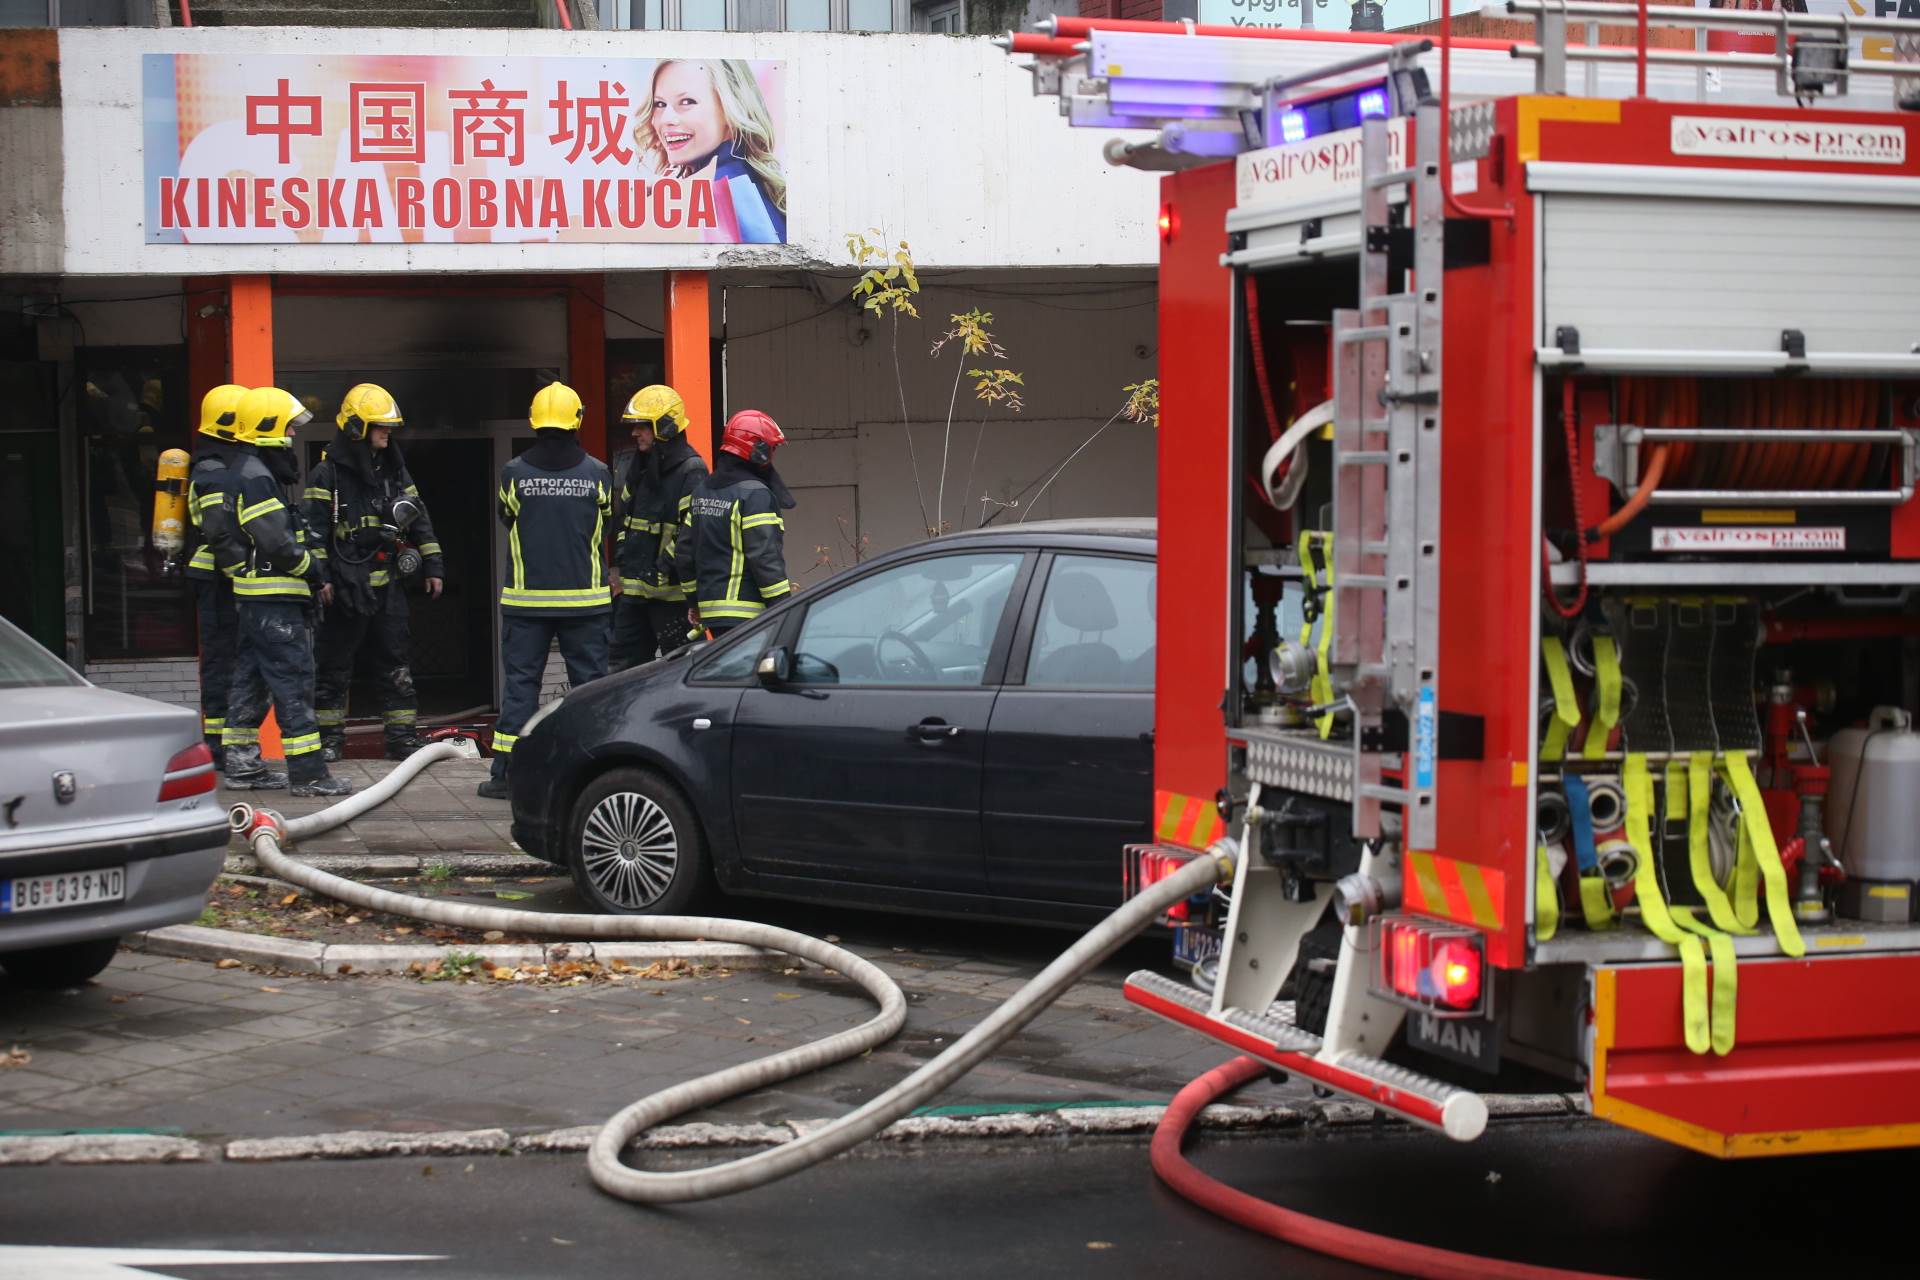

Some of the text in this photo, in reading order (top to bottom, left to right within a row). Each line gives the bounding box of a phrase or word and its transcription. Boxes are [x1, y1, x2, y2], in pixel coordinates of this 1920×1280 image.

[246, 78, 633, 167] 中国商城
[160, 168, 718, 229] KINESKA ROBNA KUĆA
[519, 478, 595, 489] ВАТРОГАСЦИ
[524, 487, 590, 497] СПАСИОЦИ
[15, 880, 40, 908] BG
[1420, 1012, 1481, 1058] MAN
